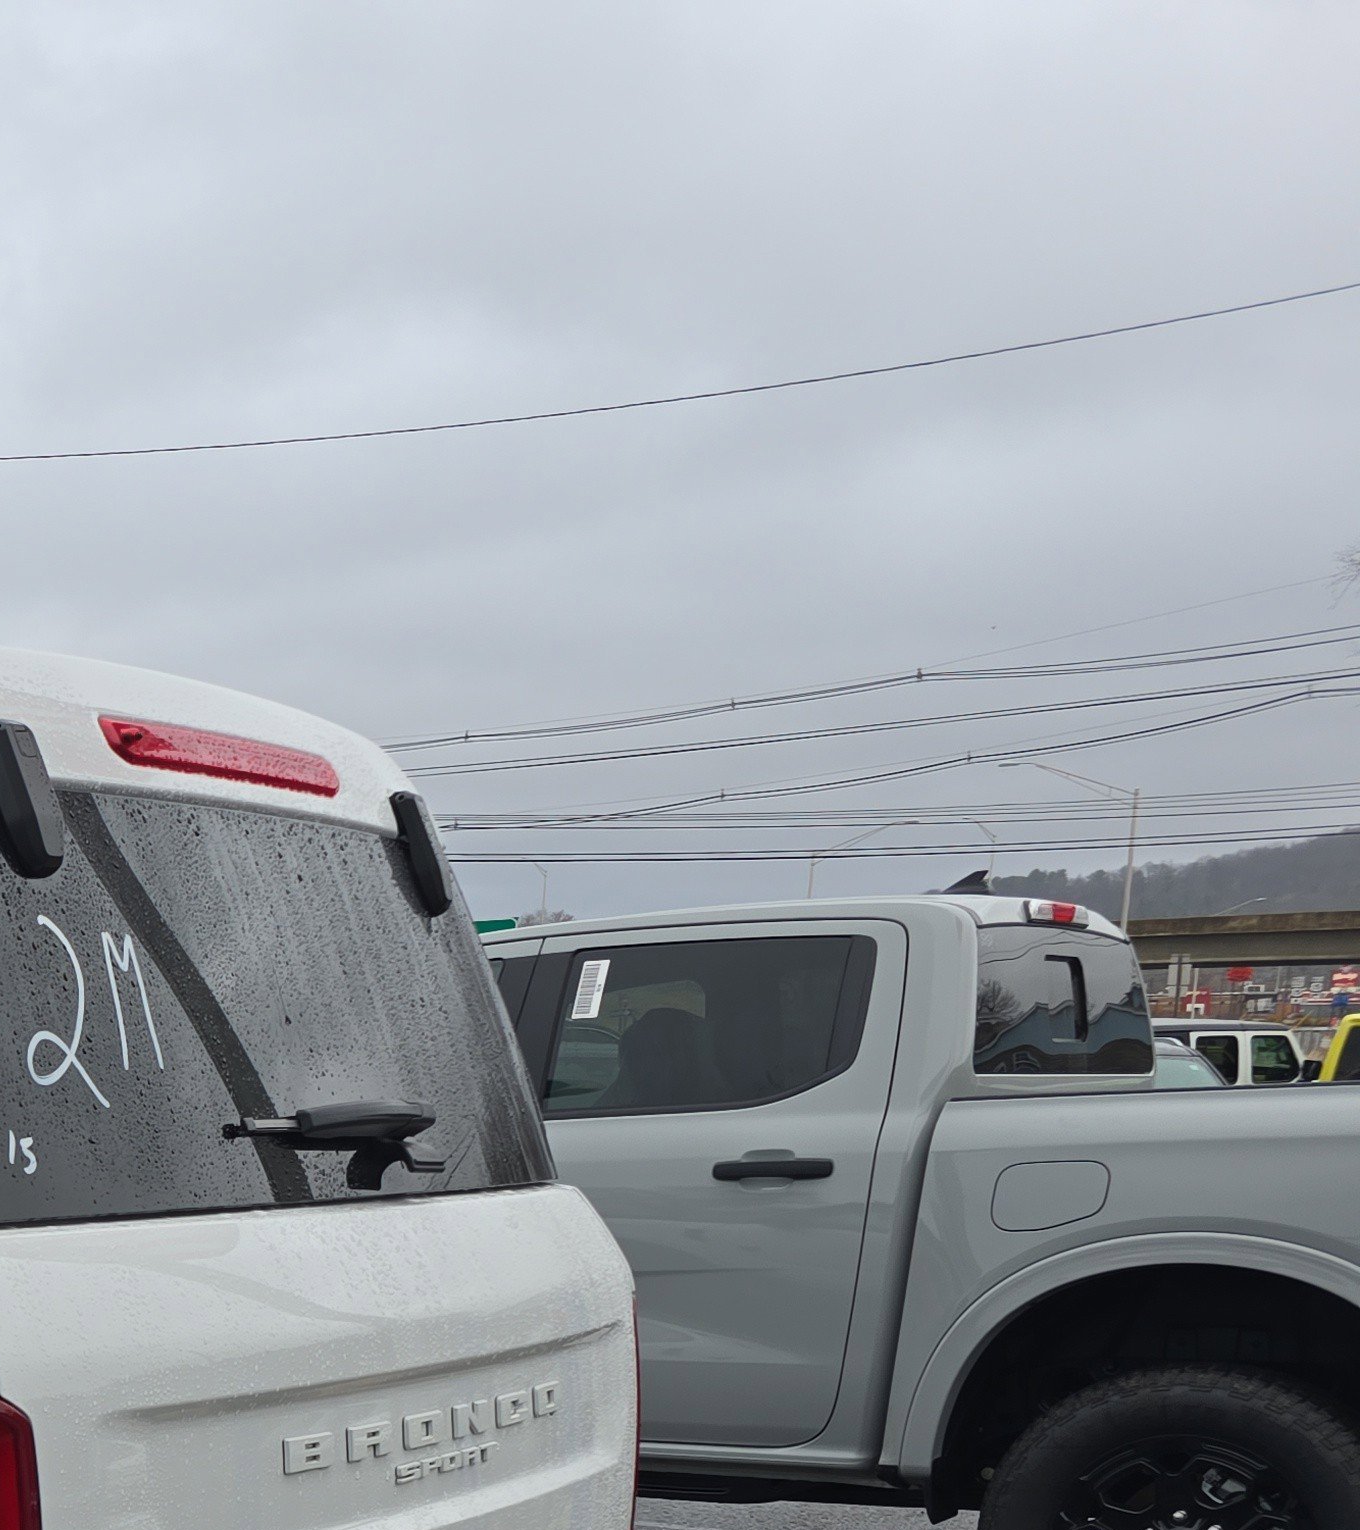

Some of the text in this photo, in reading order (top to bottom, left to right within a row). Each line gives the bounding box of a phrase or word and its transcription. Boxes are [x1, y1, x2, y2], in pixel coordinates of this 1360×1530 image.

[26, 914, 164, 1109] 2M
[8, 1130, 39, 1175] 15
[282, 1380, 560, 1476] BRONCO
[395, 1441, 499, 1485] SPORT
